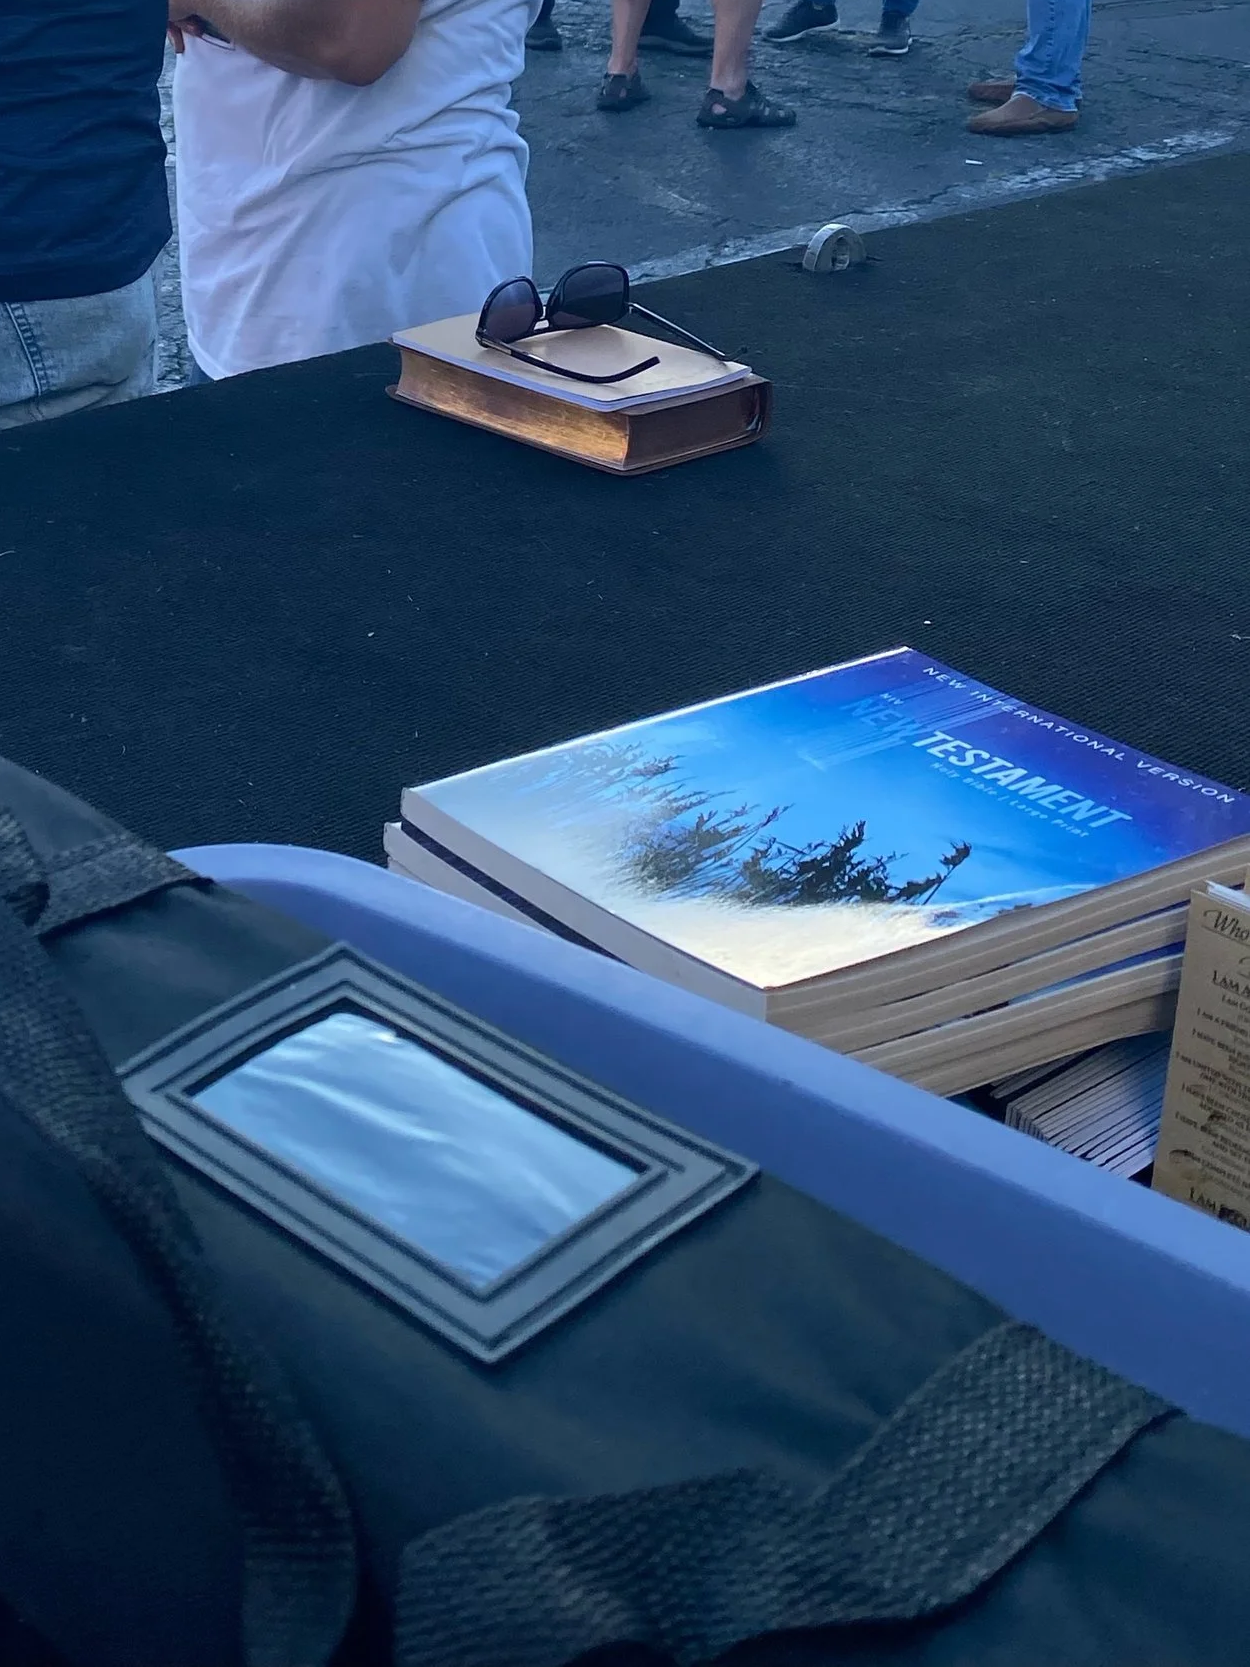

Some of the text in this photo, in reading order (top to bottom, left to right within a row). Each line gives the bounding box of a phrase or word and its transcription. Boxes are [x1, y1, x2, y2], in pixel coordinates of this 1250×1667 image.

[879, 692, 905, 706] NIV
[922, 665, 1237, 805] NEW INTERNATIONAL VERSION
[911, 730, 1134, 829] TESTAMENT
[1008, 799, 1049, 820] Large
[1203, 909, 1250, 942] Who
